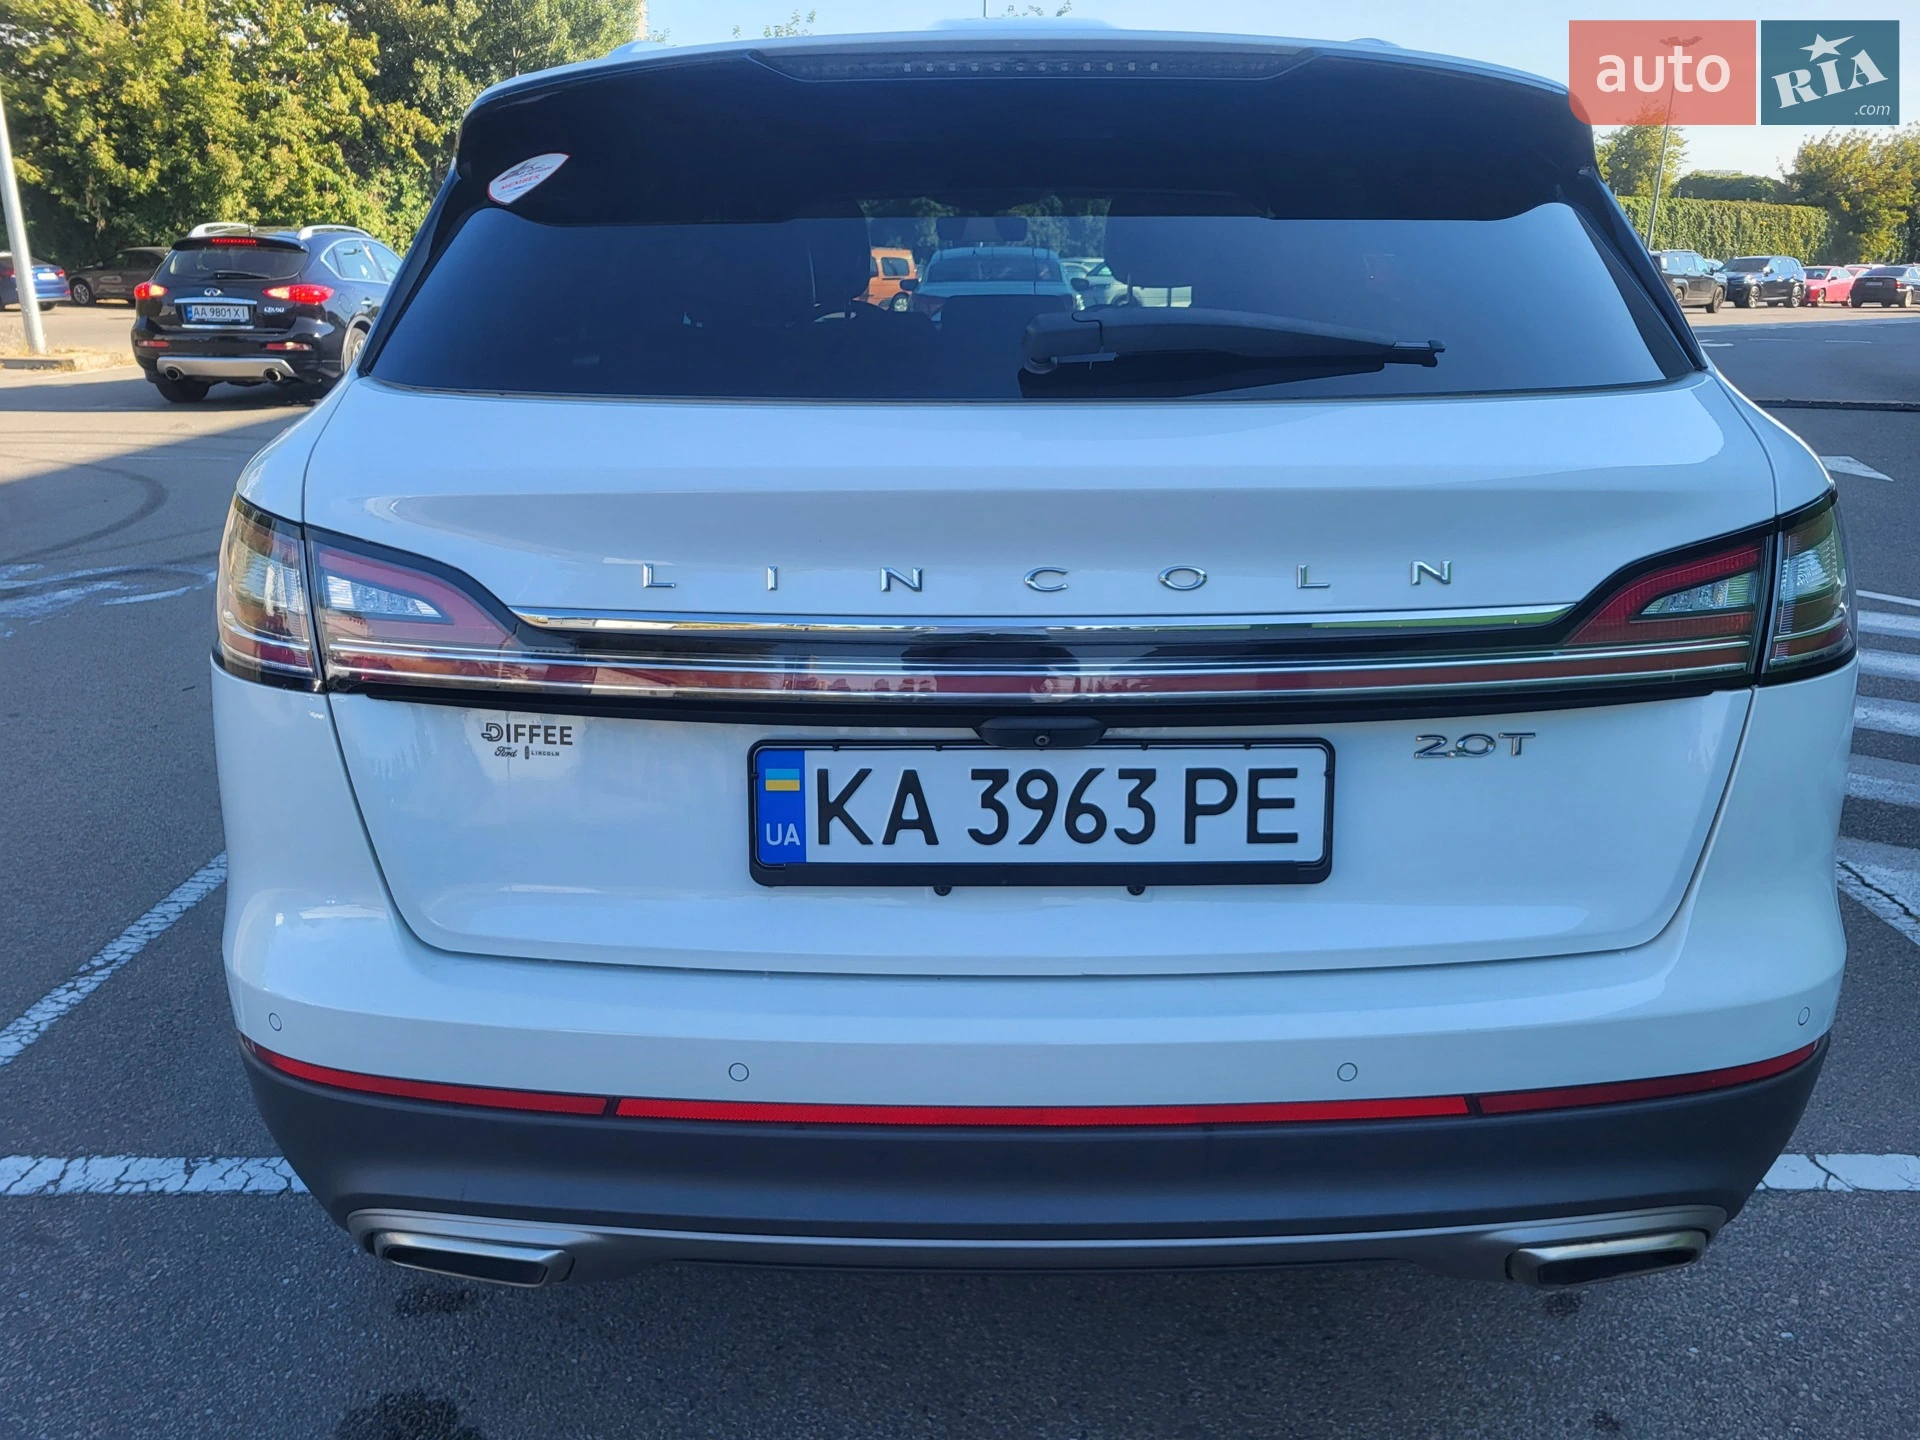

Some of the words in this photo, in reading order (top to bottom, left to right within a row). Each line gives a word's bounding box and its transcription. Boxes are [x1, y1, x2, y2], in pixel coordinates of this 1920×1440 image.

[501, 174, 541, 190] MEMBER
[193, 307, 208, 317] AA
[210, 307, 231, 317] 9801
[233, 307, 245, 317] XI
[643, 559, 1452, 593] LINCOLN
[481, 722, 573, 746] DIFFEE
[1414, 732, 1536, 758] 2.0T
[494, 745, 518, 758] Ford
[817, 768, 939, 845] KA
[967, 768, 1156, 845] 3963
[1184, 768, 1298, 844] PE
[765, 823, 801, 847] UA
